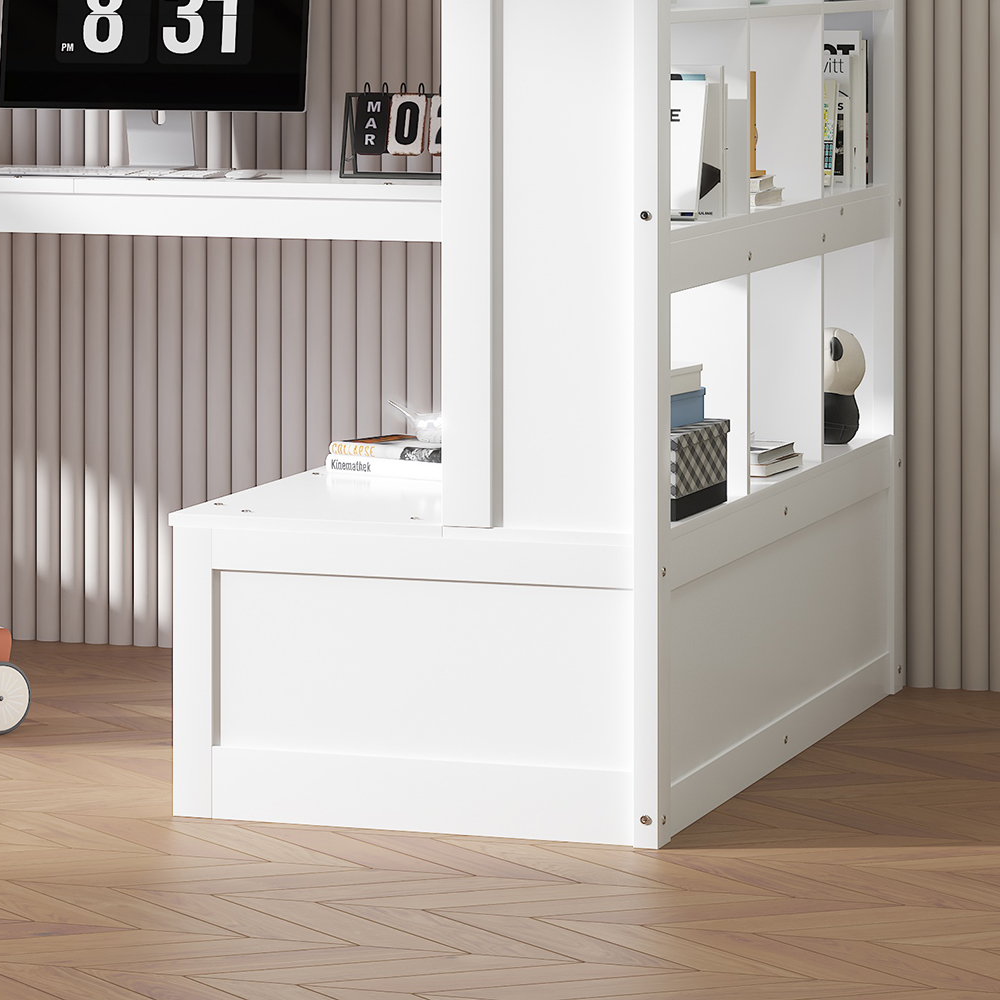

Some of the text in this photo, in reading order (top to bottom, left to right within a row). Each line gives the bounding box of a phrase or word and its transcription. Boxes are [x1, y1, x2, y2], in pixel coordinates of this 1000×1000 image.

[61, 43, 74, 52] PM
[363, 101, 382, 146] MAR
[331, 442, 376, 458] COLLAPSE
[330, 459, 372, 472] Kinemathek
